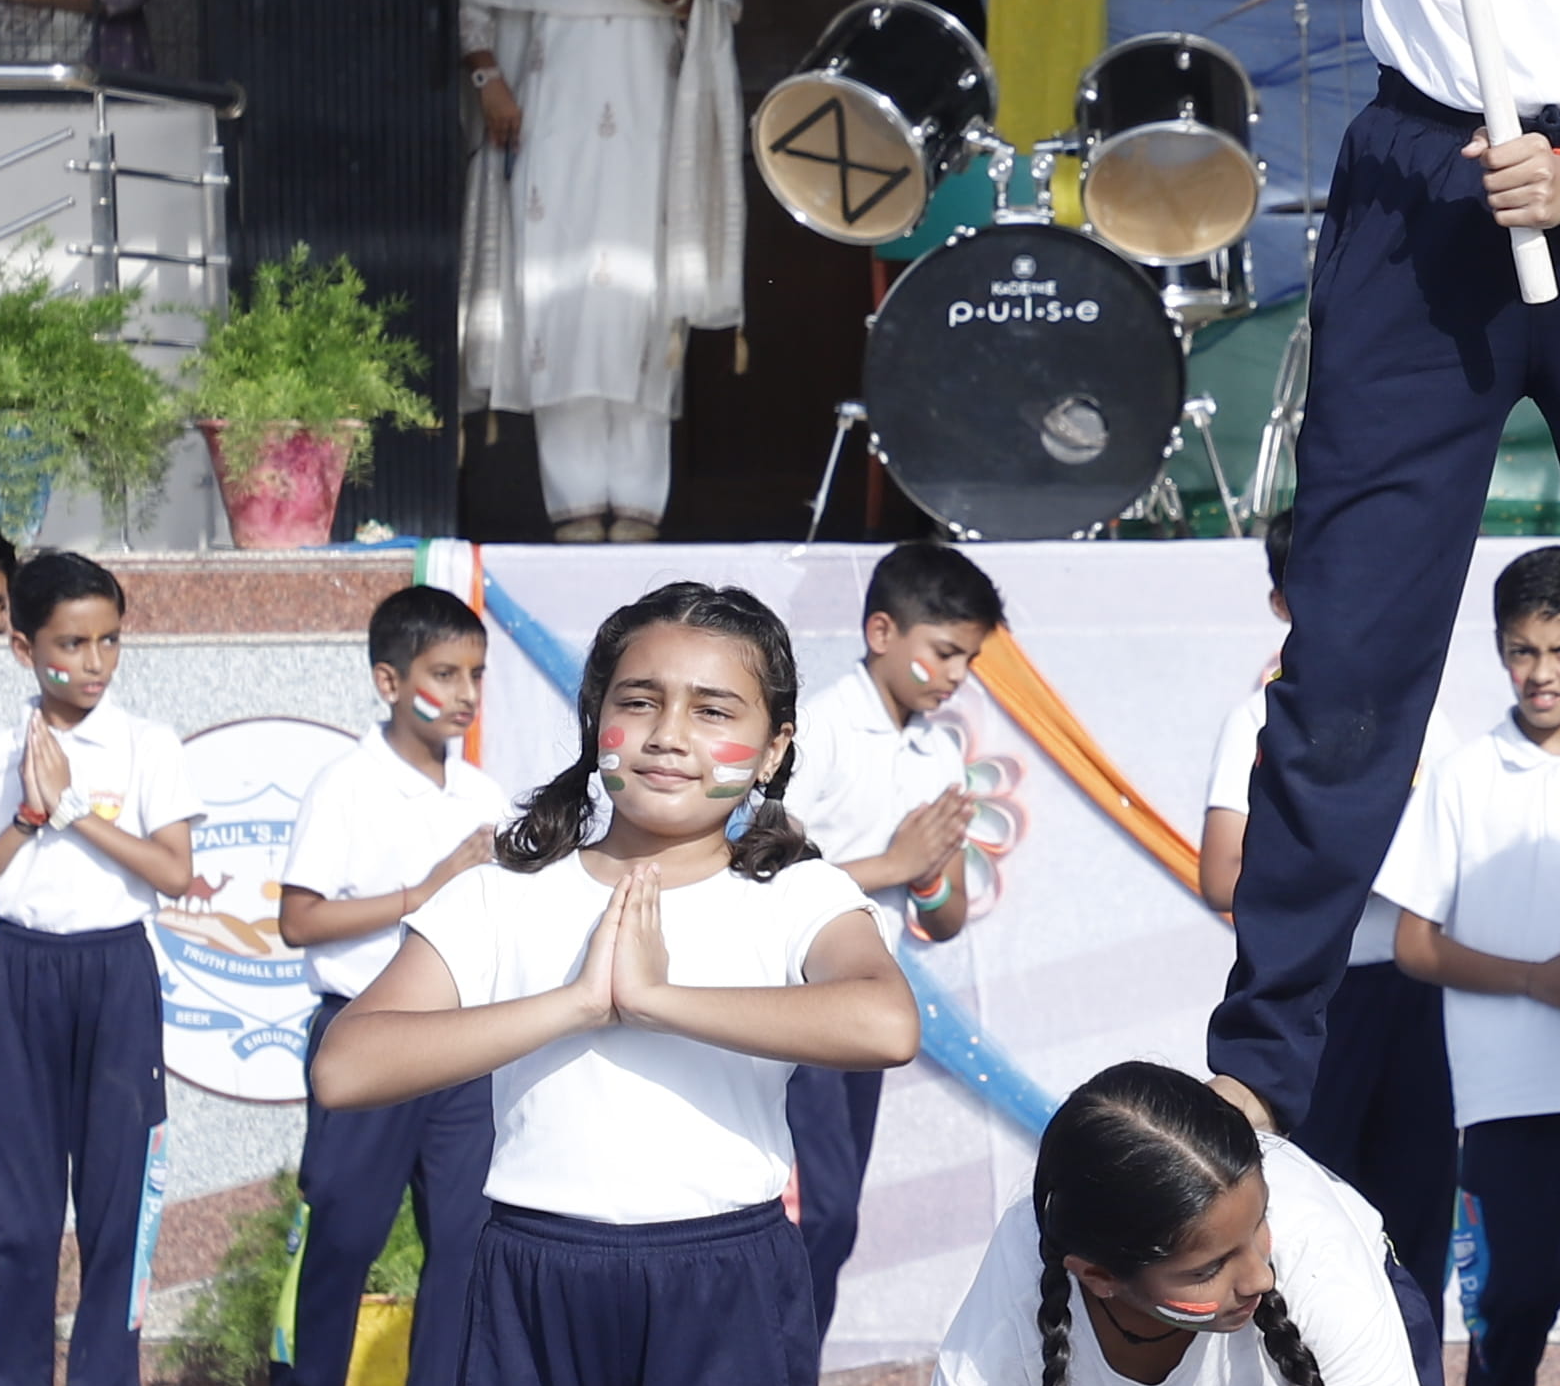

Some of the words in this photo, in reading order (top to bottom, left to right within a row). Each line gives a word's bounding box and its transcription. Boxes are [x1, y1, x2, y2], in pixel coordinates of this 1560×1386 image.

[183, 943, 227, 971] TRUTH
[227, 960, 274, 979] SHALL
[275, 963, 303, 979] SET
[175, 1010, 212, 1027] SEEK
[242, 1030, 304, 1052] ENDURE
